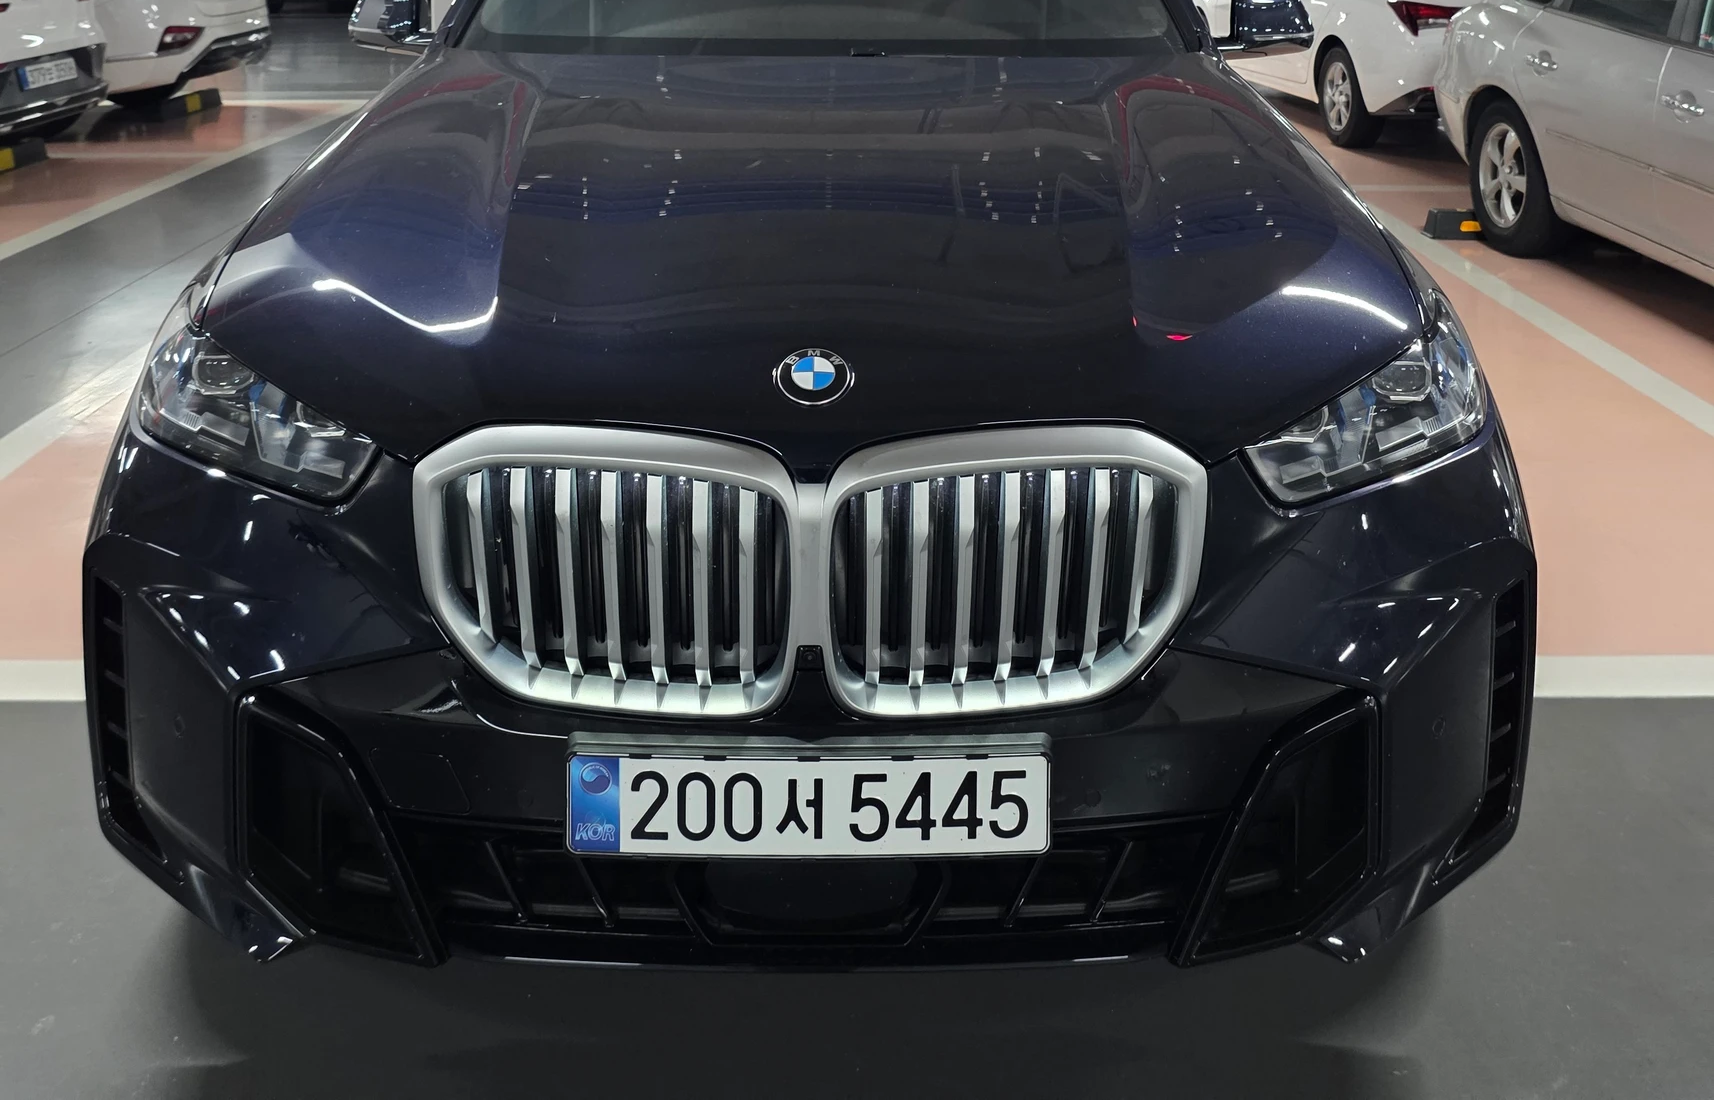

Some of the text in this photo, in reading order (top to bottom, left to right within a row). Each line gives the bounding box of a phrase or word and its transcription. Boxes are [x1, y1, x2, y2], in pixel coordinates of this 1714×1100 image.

[630, 770, 1030, 842] 200서 5445
[574, 822, 616, 842] KOR
